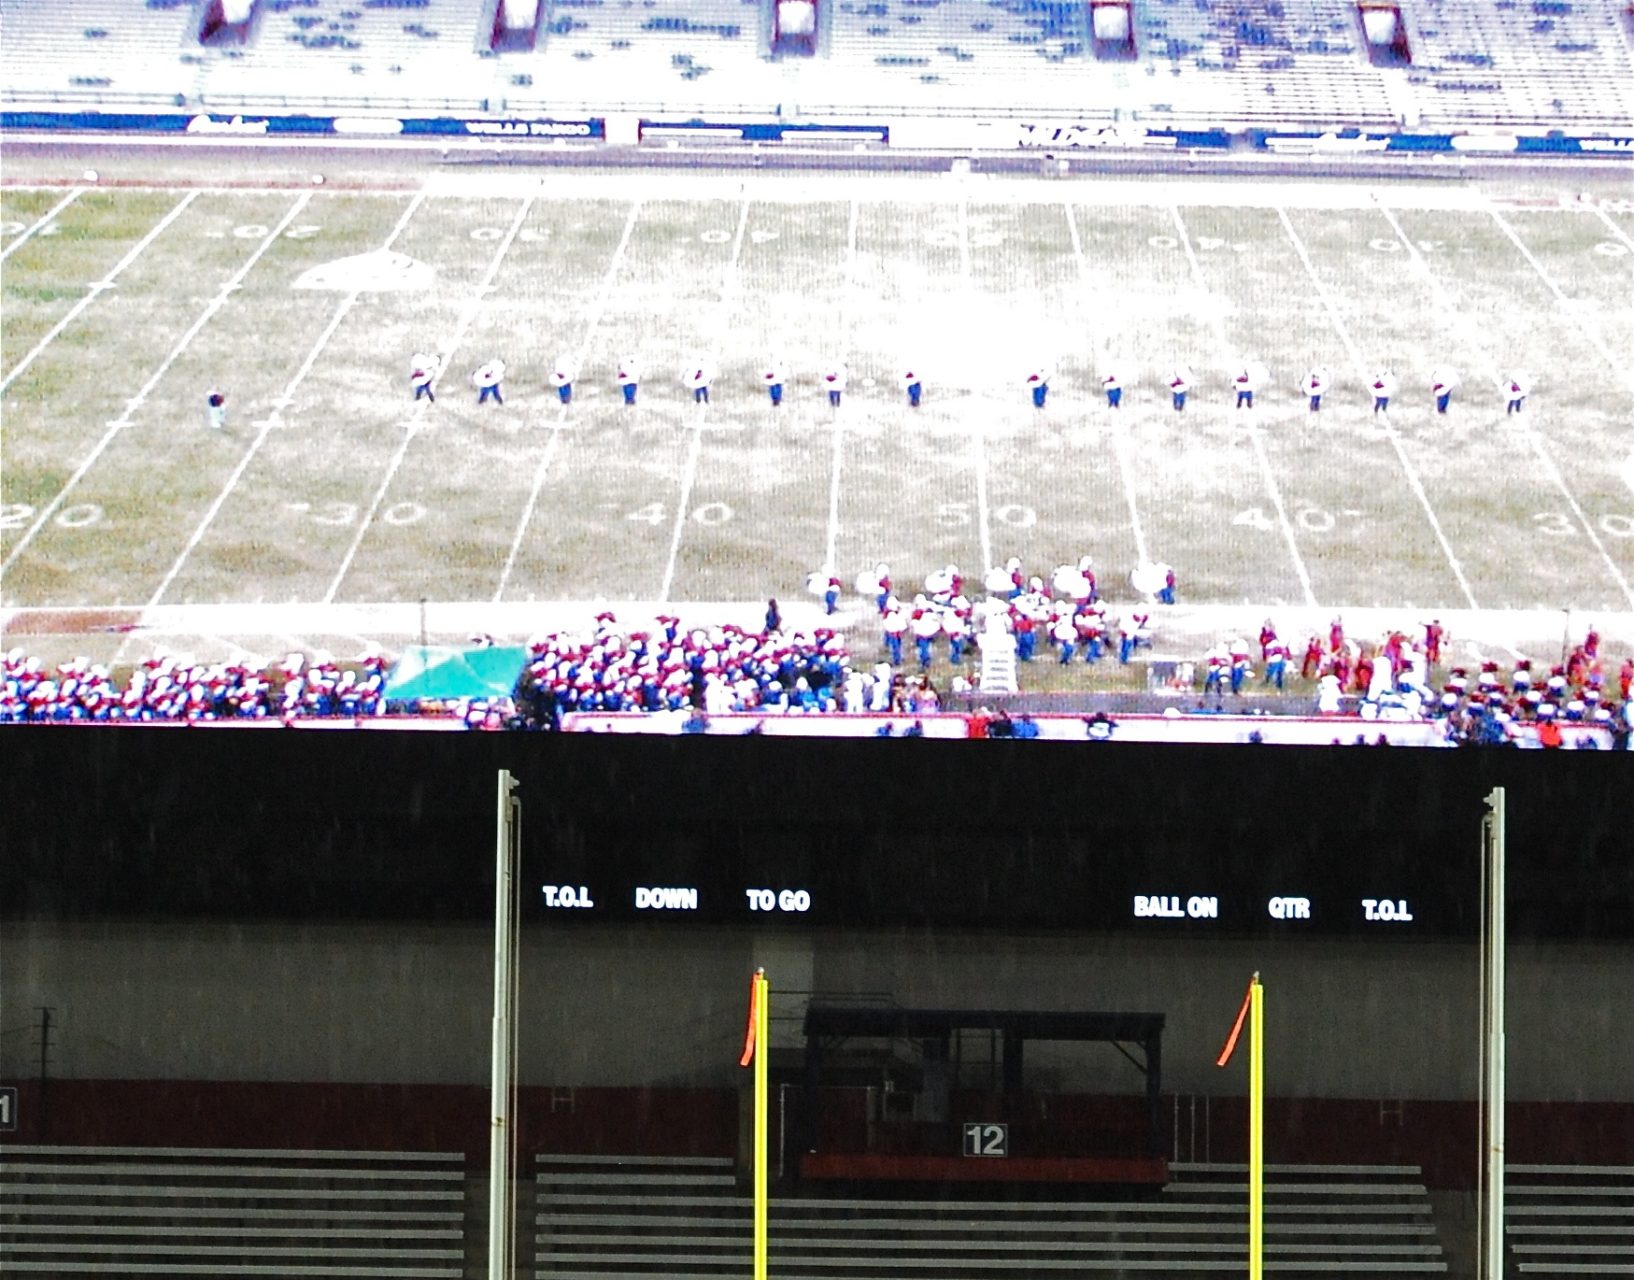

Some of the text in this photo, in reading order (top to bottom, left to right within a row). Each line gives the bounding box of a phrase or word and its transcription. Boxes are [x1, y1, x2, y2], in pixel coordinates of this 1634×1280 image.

[636, 887, 698, 909] DOWN
[746, 889, 811, 911] TO GO
[1134, 896, 1218, 918] BALL ON
[1268, 896, 1310, 919] QTR
[967, 1126, 1005, 1155] 12
